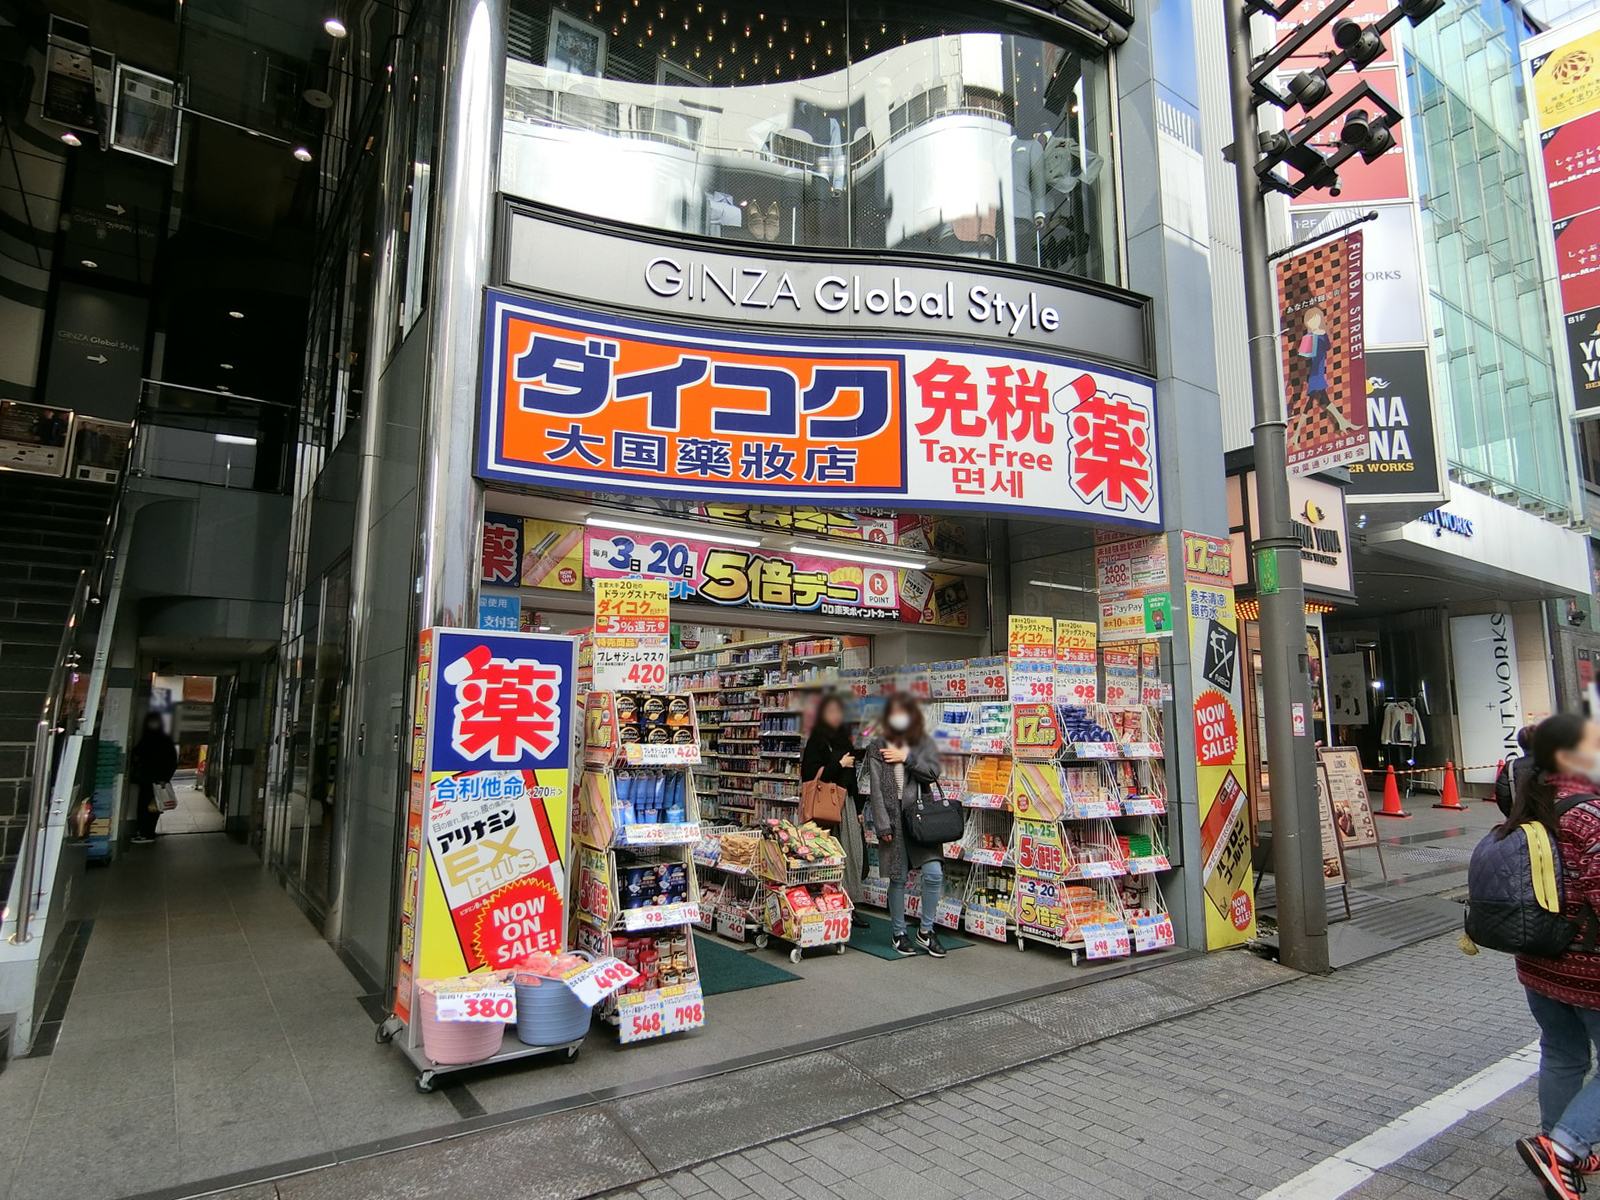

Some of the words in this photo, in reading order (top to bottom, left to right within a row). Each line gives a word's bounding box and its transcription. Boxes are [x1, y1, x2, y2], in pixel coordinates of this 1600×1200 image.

[1348, 242, 1361, 300] FUTABA
[1364, 270, 1402, 282] ORKS
[645, 256, 803, 309] GINZA
[813, 274, 956, 319] Global
[967, 285, 1061, 336] Style
[1567, 313, 1586, 324] B1F
[58, 330, 89, 342] GINZA
[90, 336, 119, 348] Global
[119, 342, 140, 352] Style
[1349, 306, 1363, 361] STREET
[514, 329, 894, 440] ダイコク
[914, 357, 1055, 446] 免税
[1367, 397, 1409, 428] NA
[545, 423, 859, 484] 大国藥妝店
[1053, 372, 1153, 510] 薬
[1288, 433, 1366, 464] 防犯カメラ作動中
[1369, 430, 1412, 461] NA
[919, 438, 1054, 473] Tax-Free
[1291, 447, 1365, 475] 双葉通り親和会
[1367, 462, 1415, 473] WORKS
[951, 468, 1025, 499] 면세
[597, 599, 652, 615] ダイコク
[869, 596, 889, 604] POINT
[483, 615, 518, 628] 支付宝
[1010, 632, 1043, 644] ダイコク
[1057, 636, 1087, 648] ダイコク
[1491, 613, 1513, 705] WORKS
[984, 676, 1006, 689] 98
[1030, 682, 1054, 696] 398
[1074, 685, 1096, 698] 98
[1214, 673, 1231, 688] NEO
[445, 645, 558, 759] 薬
[1196, 701, 1226, 726] NOW
[1202, 721, 1225, 742] ON
[1500, 708, 1519, 762] OINT
[1201, 735, 1235, 760] SALE!
[435, 776, 525, 801] 合利他命
[437, 808, 518, 855] アリナミン
[442, 825, 523, 887] EX
[466, 848, 539, 898] PLUS
[493, 895, 546, 928] NOW
[1231, 893, 1248, 909] NOW
[1235, 903, 1247, 917] ON
[502, 916, 542, 941] ON
[646, 910, 663, 922] 98
[823, 917, 850, 941] 278
[1154, 924, 1173, 941] 198
[497, 928, 557, 964] SALE!
